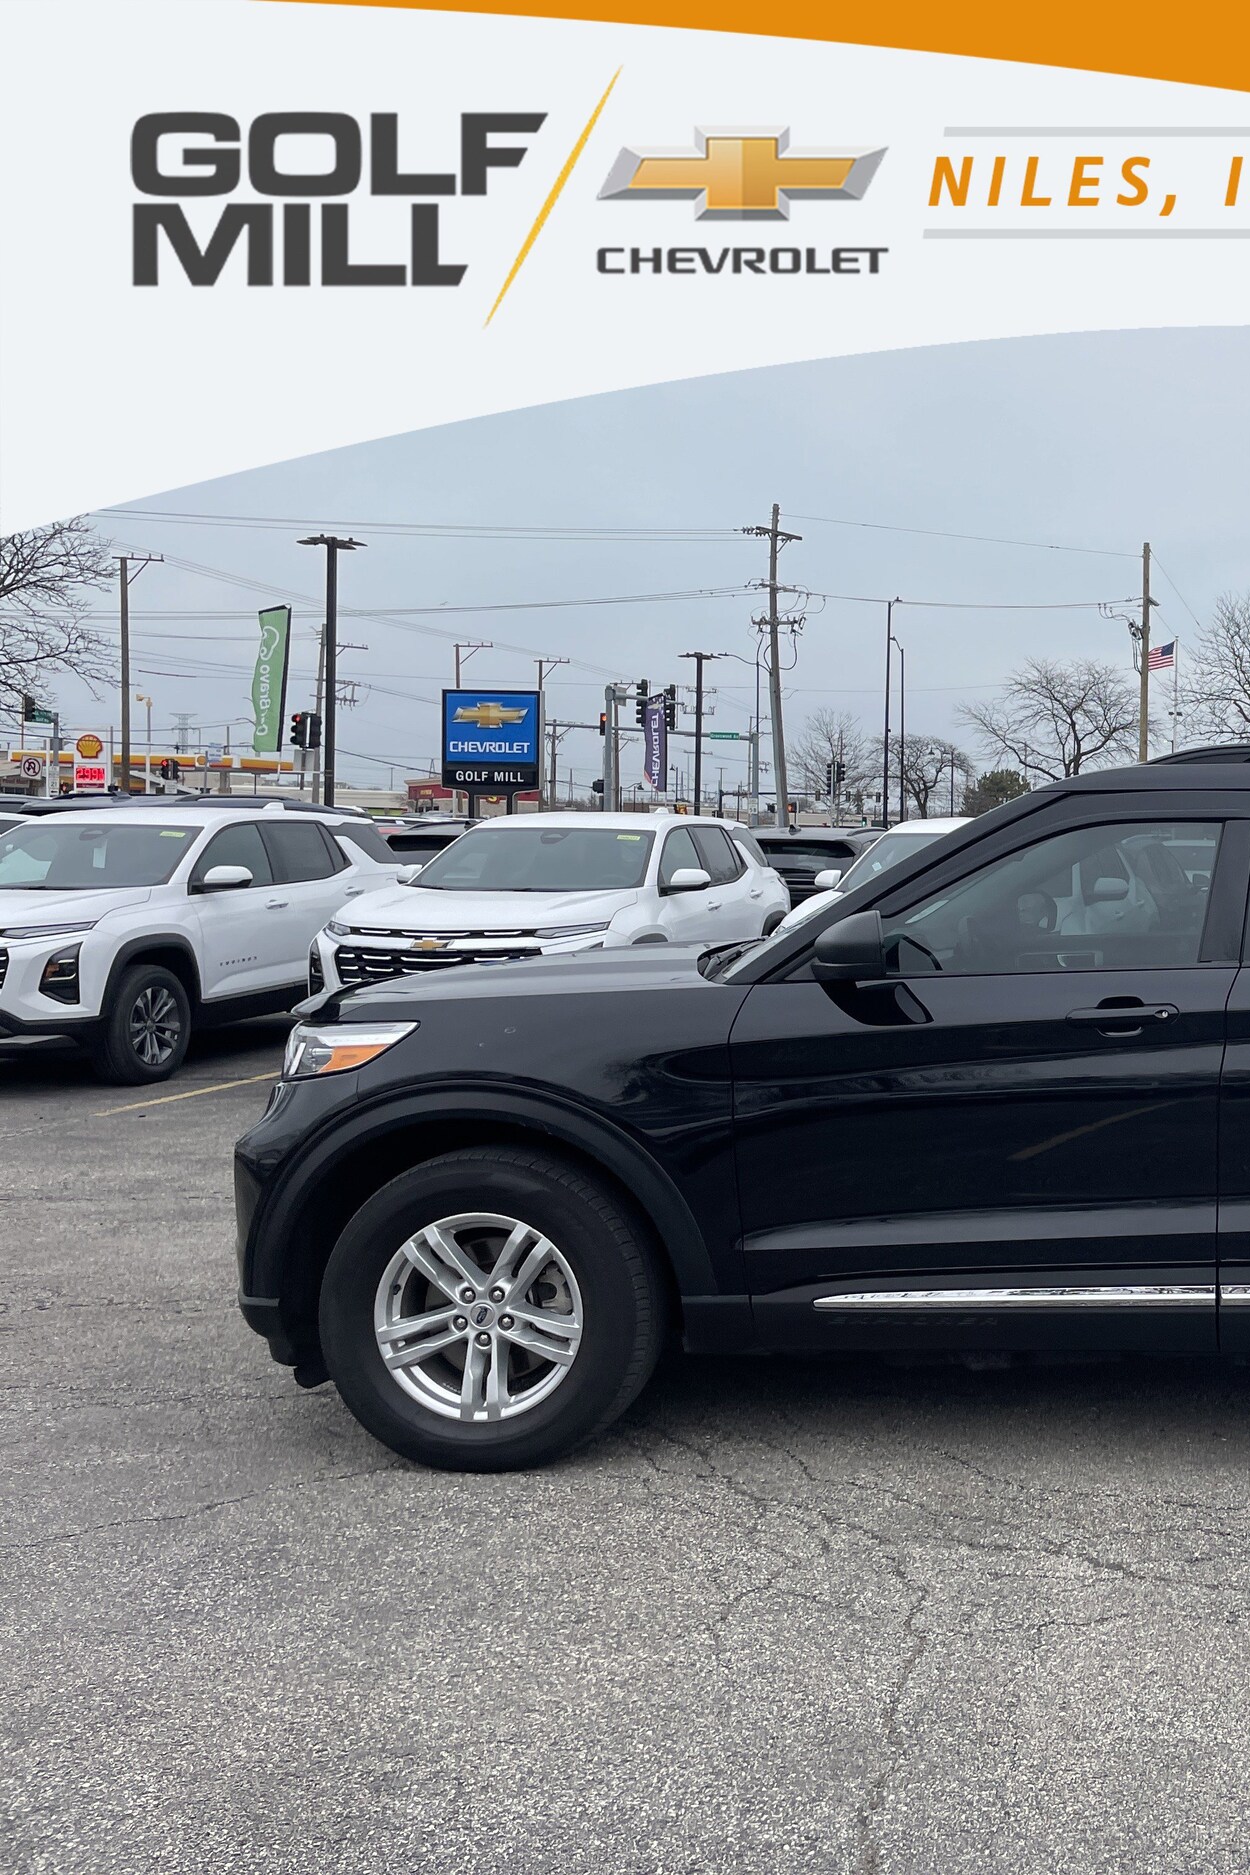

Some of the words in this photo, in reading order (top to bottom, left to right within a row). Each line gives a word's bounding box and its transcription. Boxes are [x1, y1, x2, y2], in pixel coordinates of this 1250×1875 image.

[449, 740, 531, 754] CHEVROLET
[456, 770, 490, 782] GOLF
[494, 771, 525, 782] MILL
